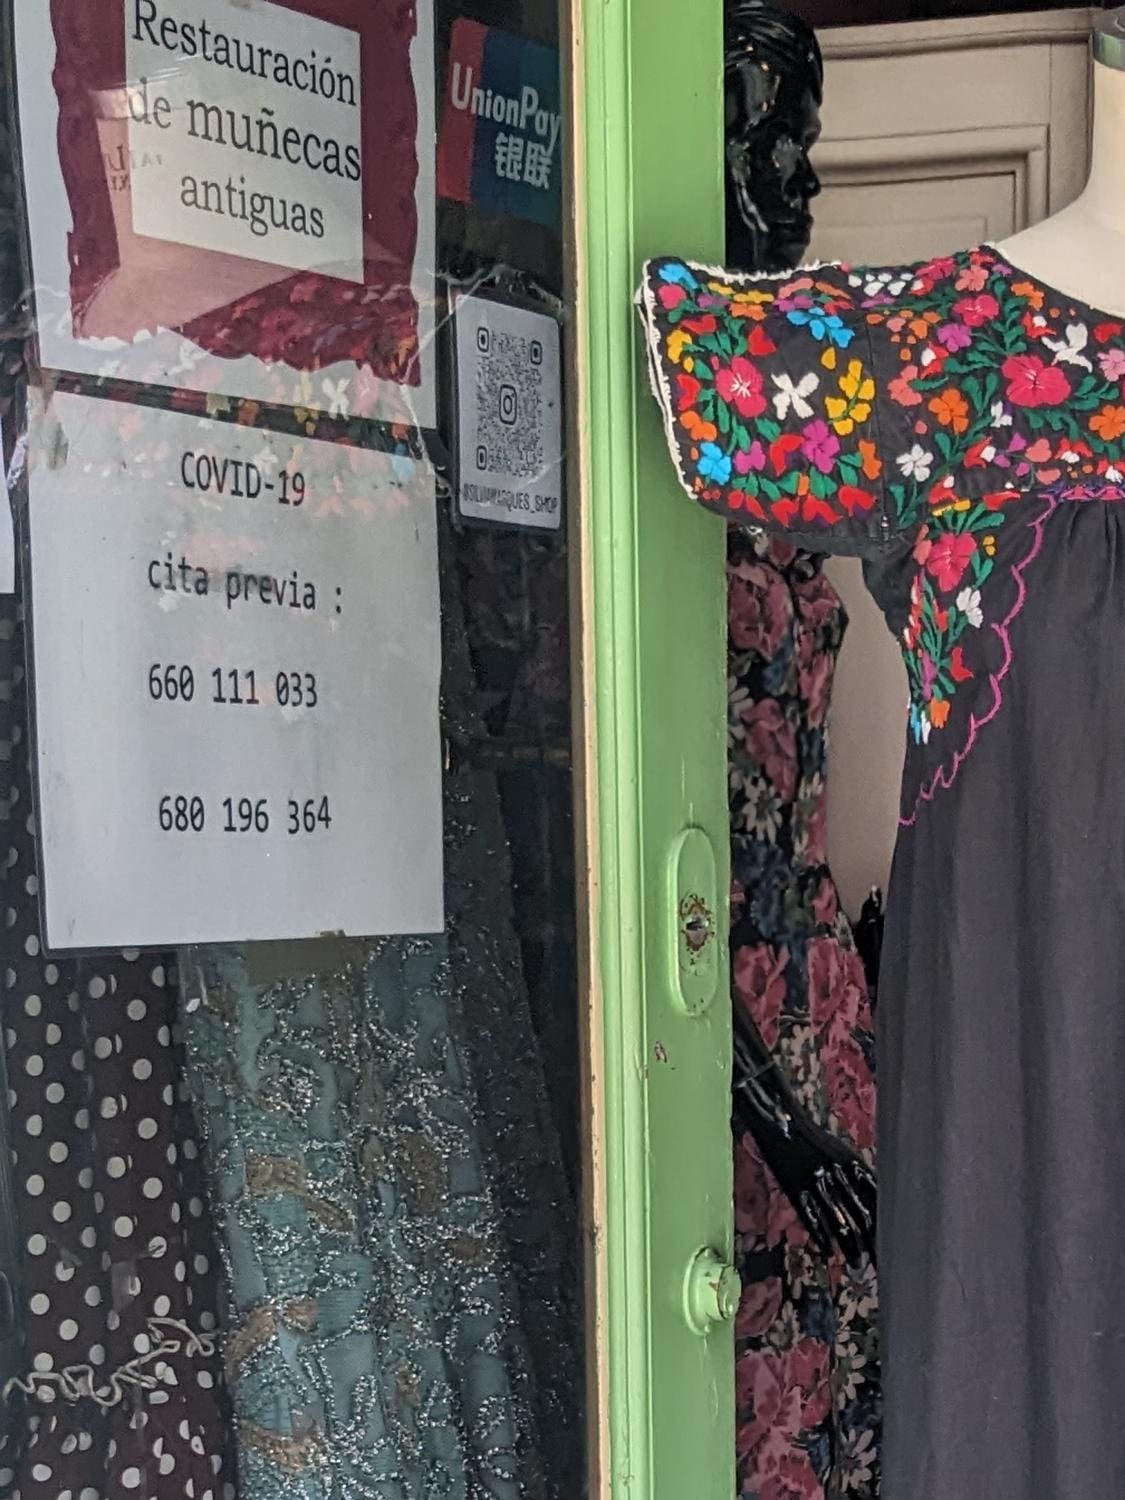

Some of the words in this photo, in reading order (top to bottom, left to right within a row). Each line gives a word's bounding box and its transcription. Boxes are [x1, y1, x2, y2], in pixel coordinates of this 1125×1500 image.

[132, 0, 356, 106] Restauración
[128, 77, 171, 128] de
[186, 99, 361, 181] muñecas
[451, 62, 561, 157] UnionPay
[495, 132, 551, 189] 银联
[180, 174, 324, 236] antiguas
[181, 451, 306, 507] COVID-19
[147, 552, 209, 596] cita
[226, 571, 317, 610] previa
[149, 664, 194, 701] 660
[212, 667, 259, 704] 111
[276, 671, 318, 707] 033
[159, 795, 205, 832] 680
[222, 797, 269, 832] 196
[288, 795, 332, 834] 364
